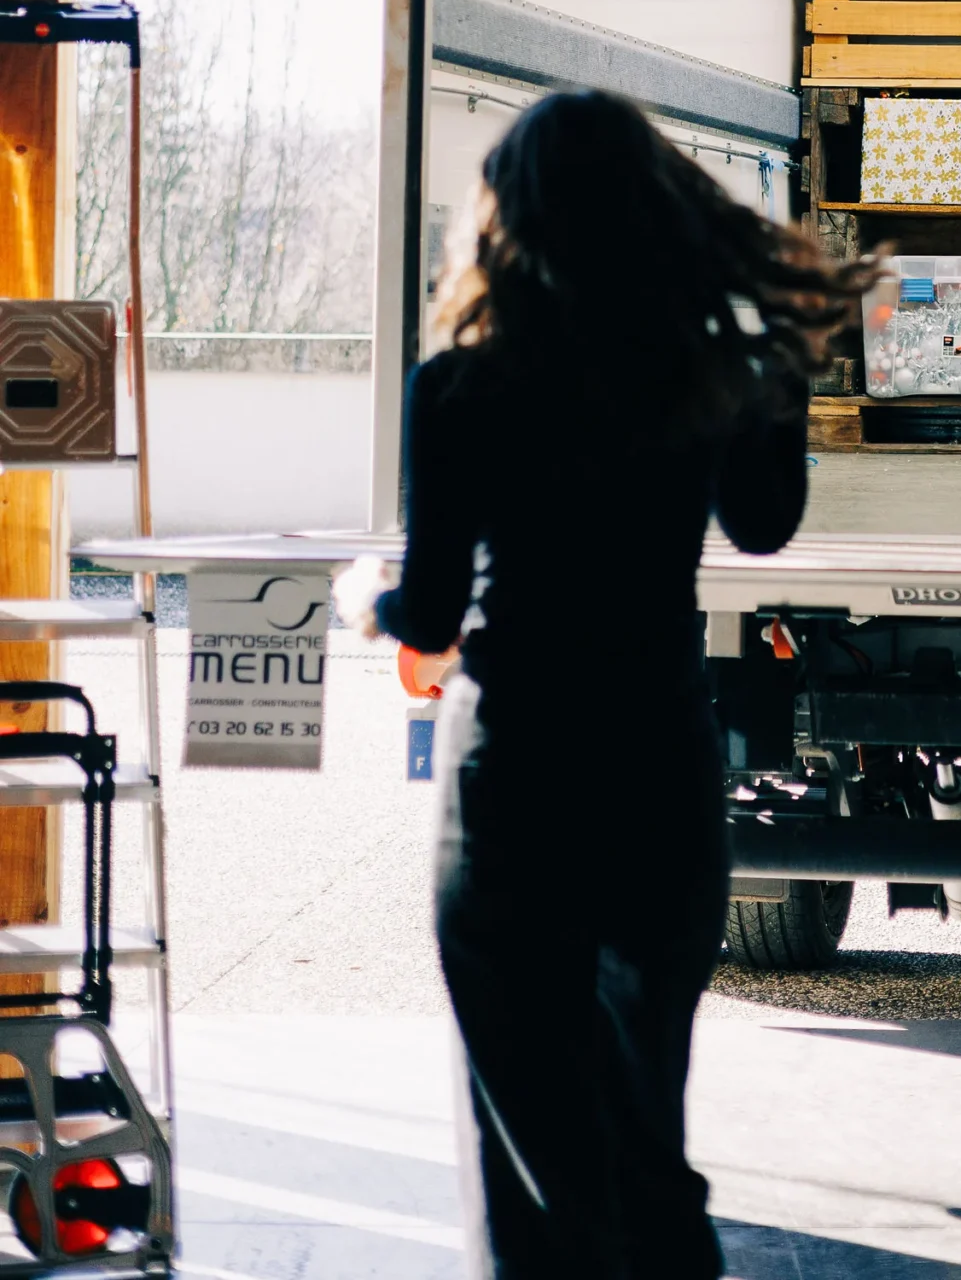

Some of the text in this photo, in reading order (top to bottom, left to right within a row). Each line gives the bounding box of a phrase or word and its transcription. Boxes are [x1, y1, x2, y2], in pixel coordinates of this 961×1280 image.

[199, 721, 321, 738] 03 20 62 15 30
[416, 756, 426, 771] F
